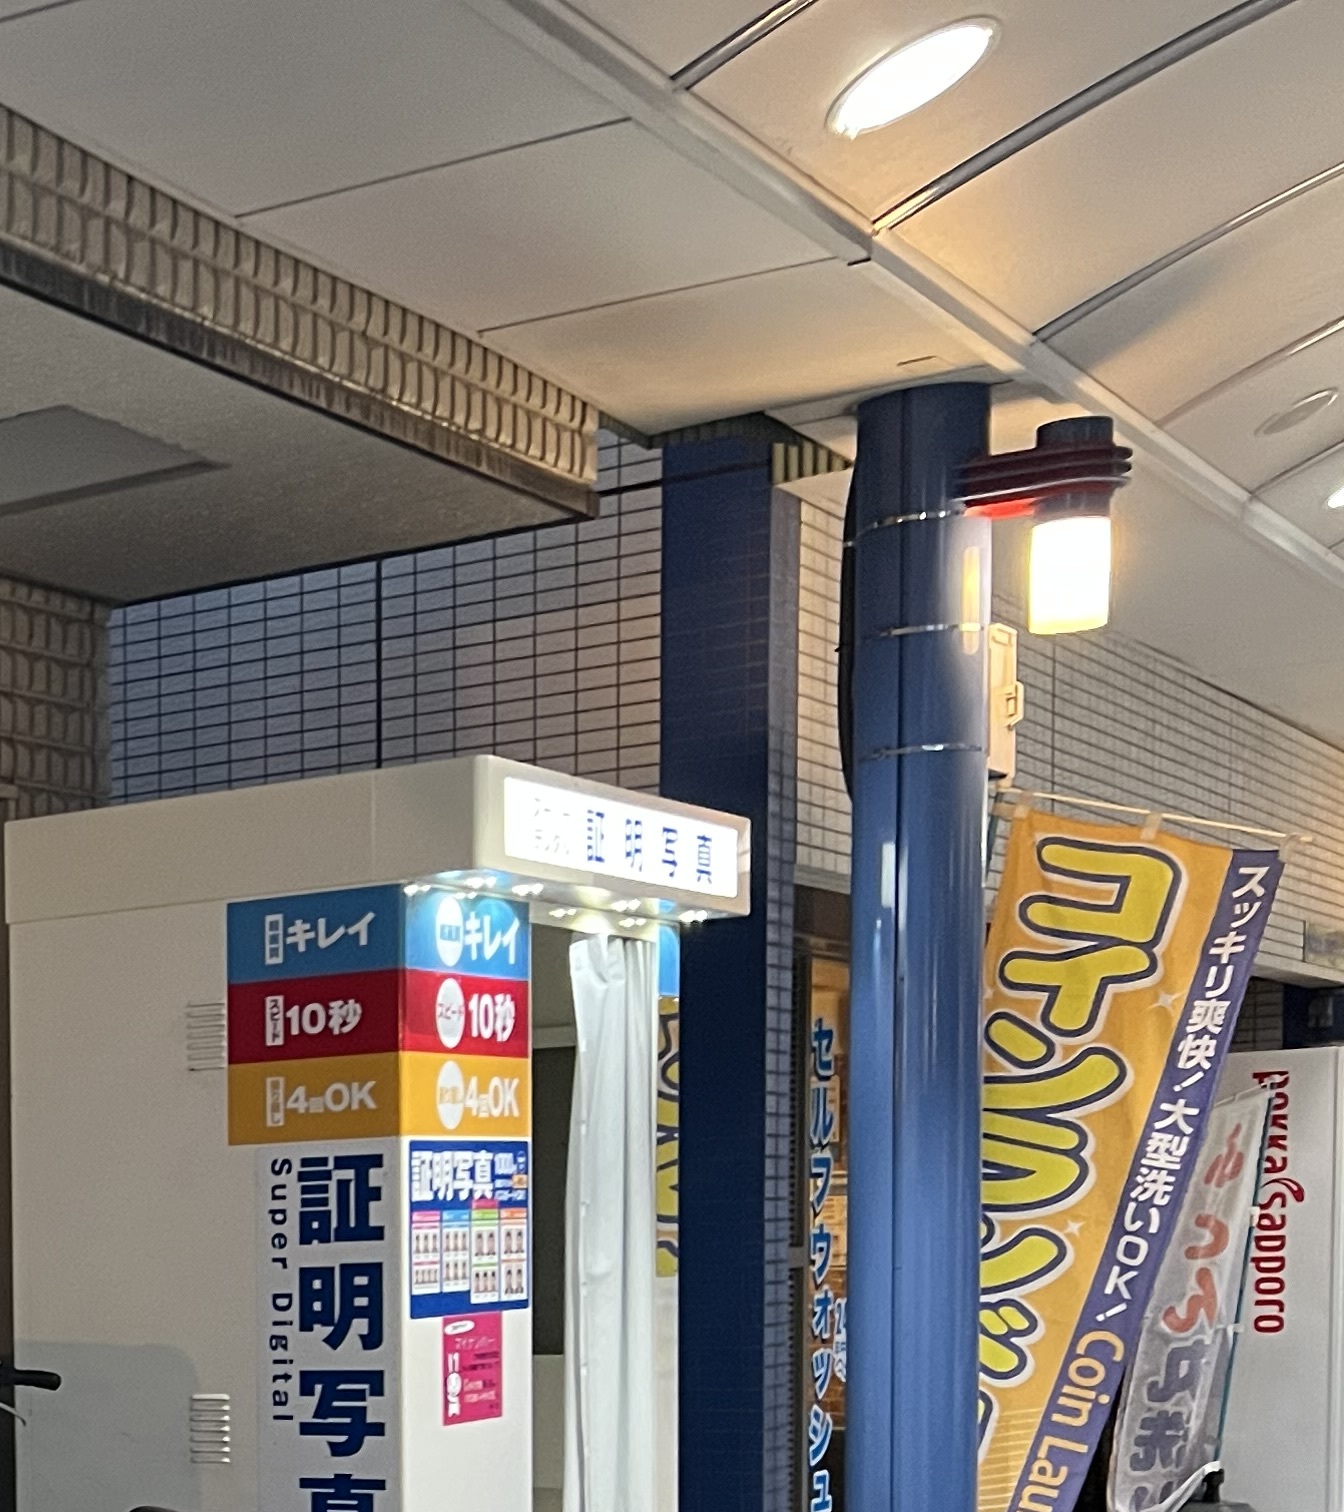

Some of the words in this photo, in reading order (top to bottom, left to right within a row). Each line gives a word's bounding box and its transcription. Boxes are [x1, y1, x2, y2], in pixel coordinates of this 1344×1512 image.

[286, 911, 376, 953] キレイ
[464, 911, 520, 965] キレイ
[286, 998, 363, 1036] 10秒
[468, 992, 516, 1042] 10秒
[268, 1157, 293, 1269] Super
[269, 1292, 294, 1421] Digital
[1050, 1330, 1124, 1428] Coin
